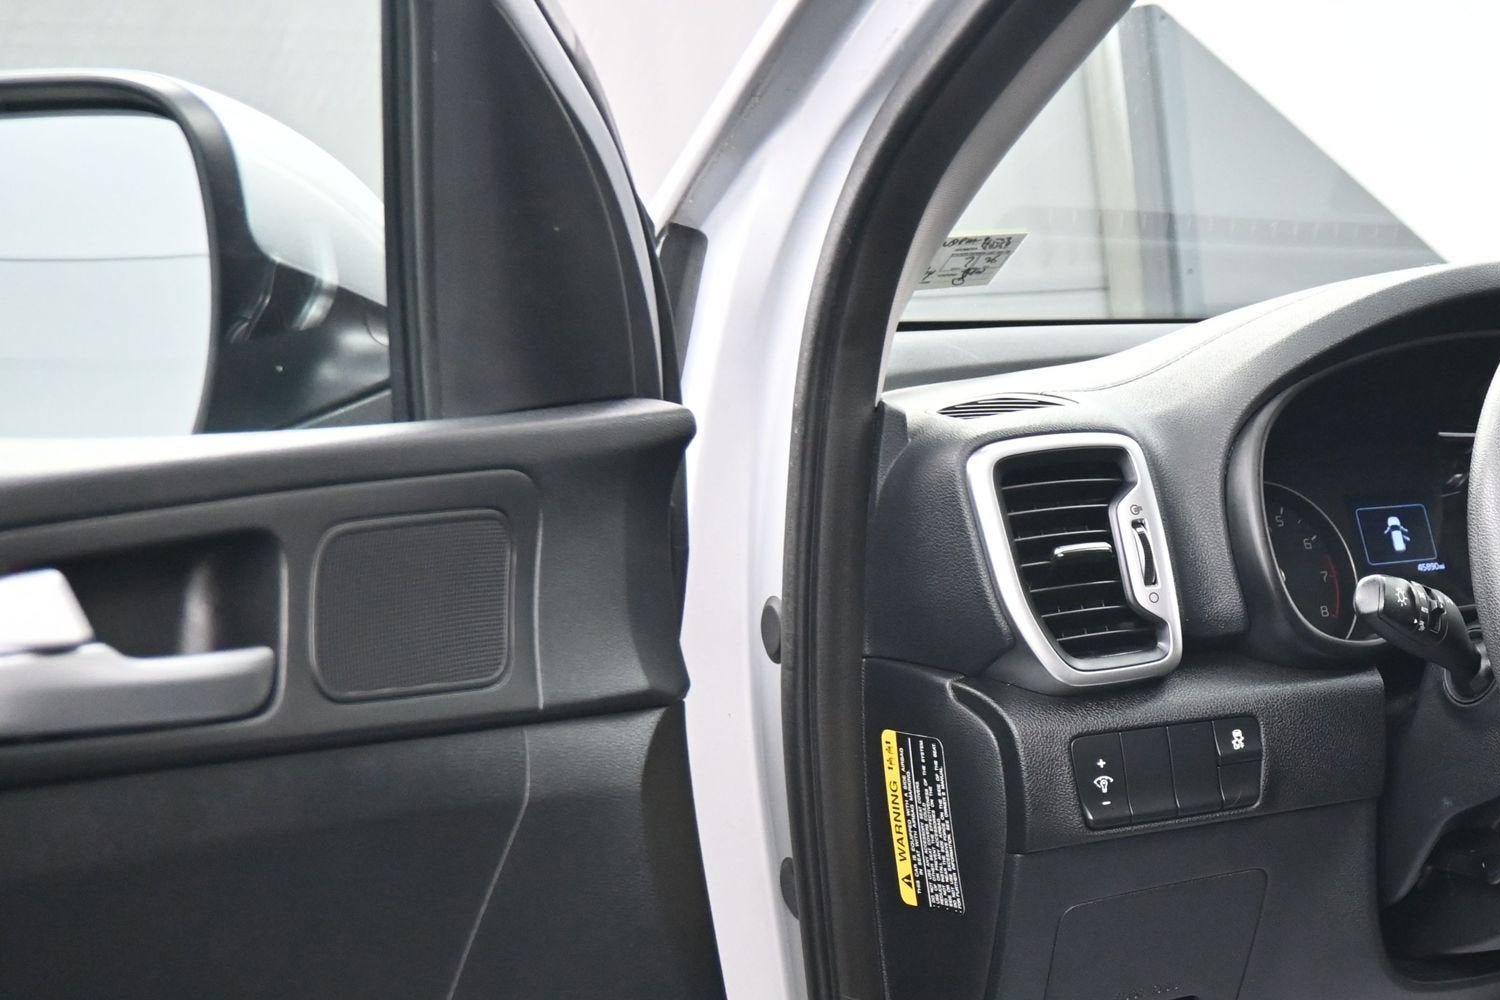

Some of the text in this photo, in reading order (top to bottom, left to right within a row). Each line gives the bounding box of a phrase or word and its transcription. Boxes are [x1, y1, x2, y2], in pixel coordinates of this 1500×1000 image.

[1275, 515, 1284, 527] 5
[1303, 538, 1312, 549] 6
[1320, 571, 1328, 582] 7
[1320, 606, 1329, 617] 8
[890, 781, 906, 861] WARNING
